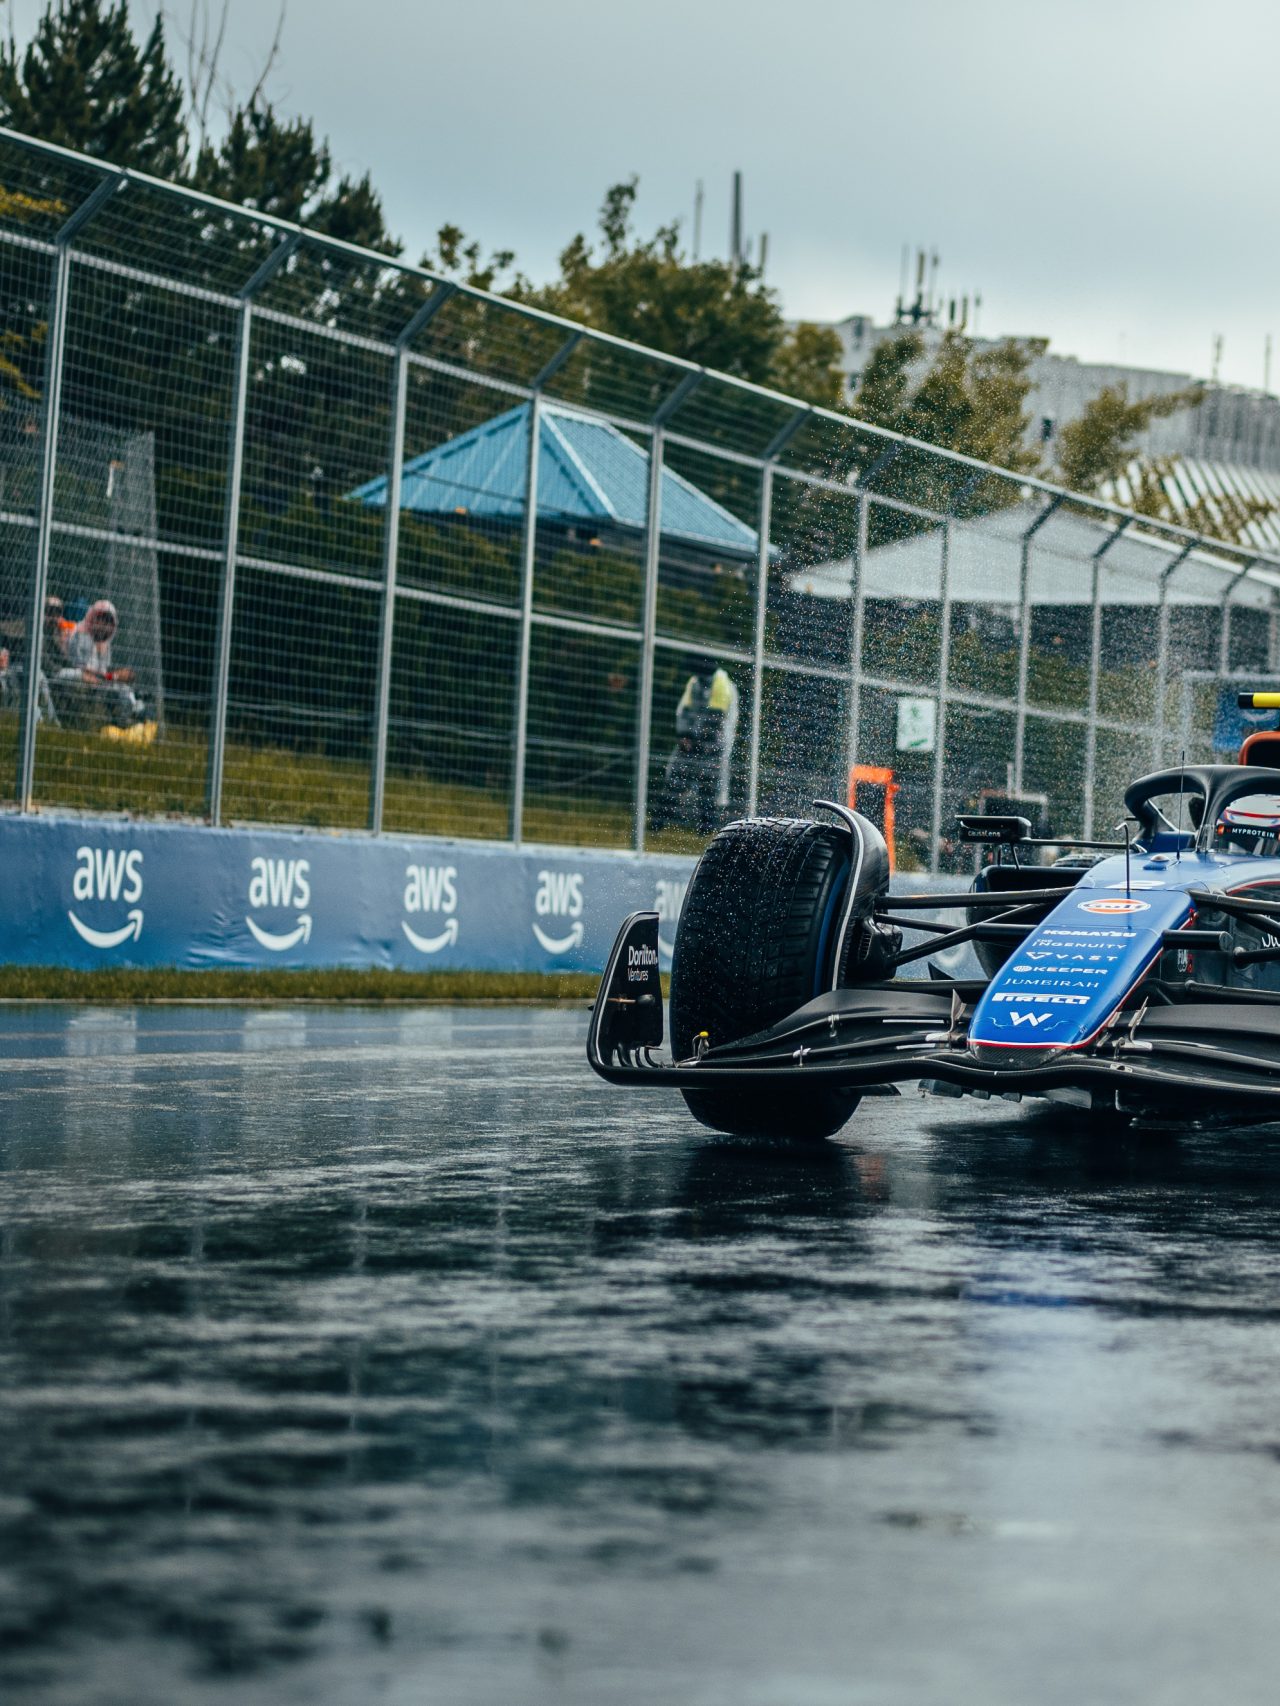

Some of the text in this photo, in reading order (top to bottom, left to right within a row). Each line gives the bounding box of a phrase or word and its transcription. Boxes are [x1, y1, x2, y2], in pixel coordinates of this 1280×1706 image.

[1231, 828, 1275, 838] MYPROTEIN
[73, 846, 144, 903] aws
[249, 856, 311, 909] aws
[404, 864, 458, 914] aws
[535, 870, 584, 918] aws
[654, 880, 690, 921] aw
[1042, 929, 1137, 938] KOMATSU
[1032, 940, 1127, 949] INGENUITY
[1056, 953, 1118, 961] VAST
[627, 967, 649, 981] Ventures
[1033, 966, 1108, 975] KEEPER
[1002, 978, 1099, 988] JUMEIRAH
[991, 992, 1091, 1005] PIRELLI
